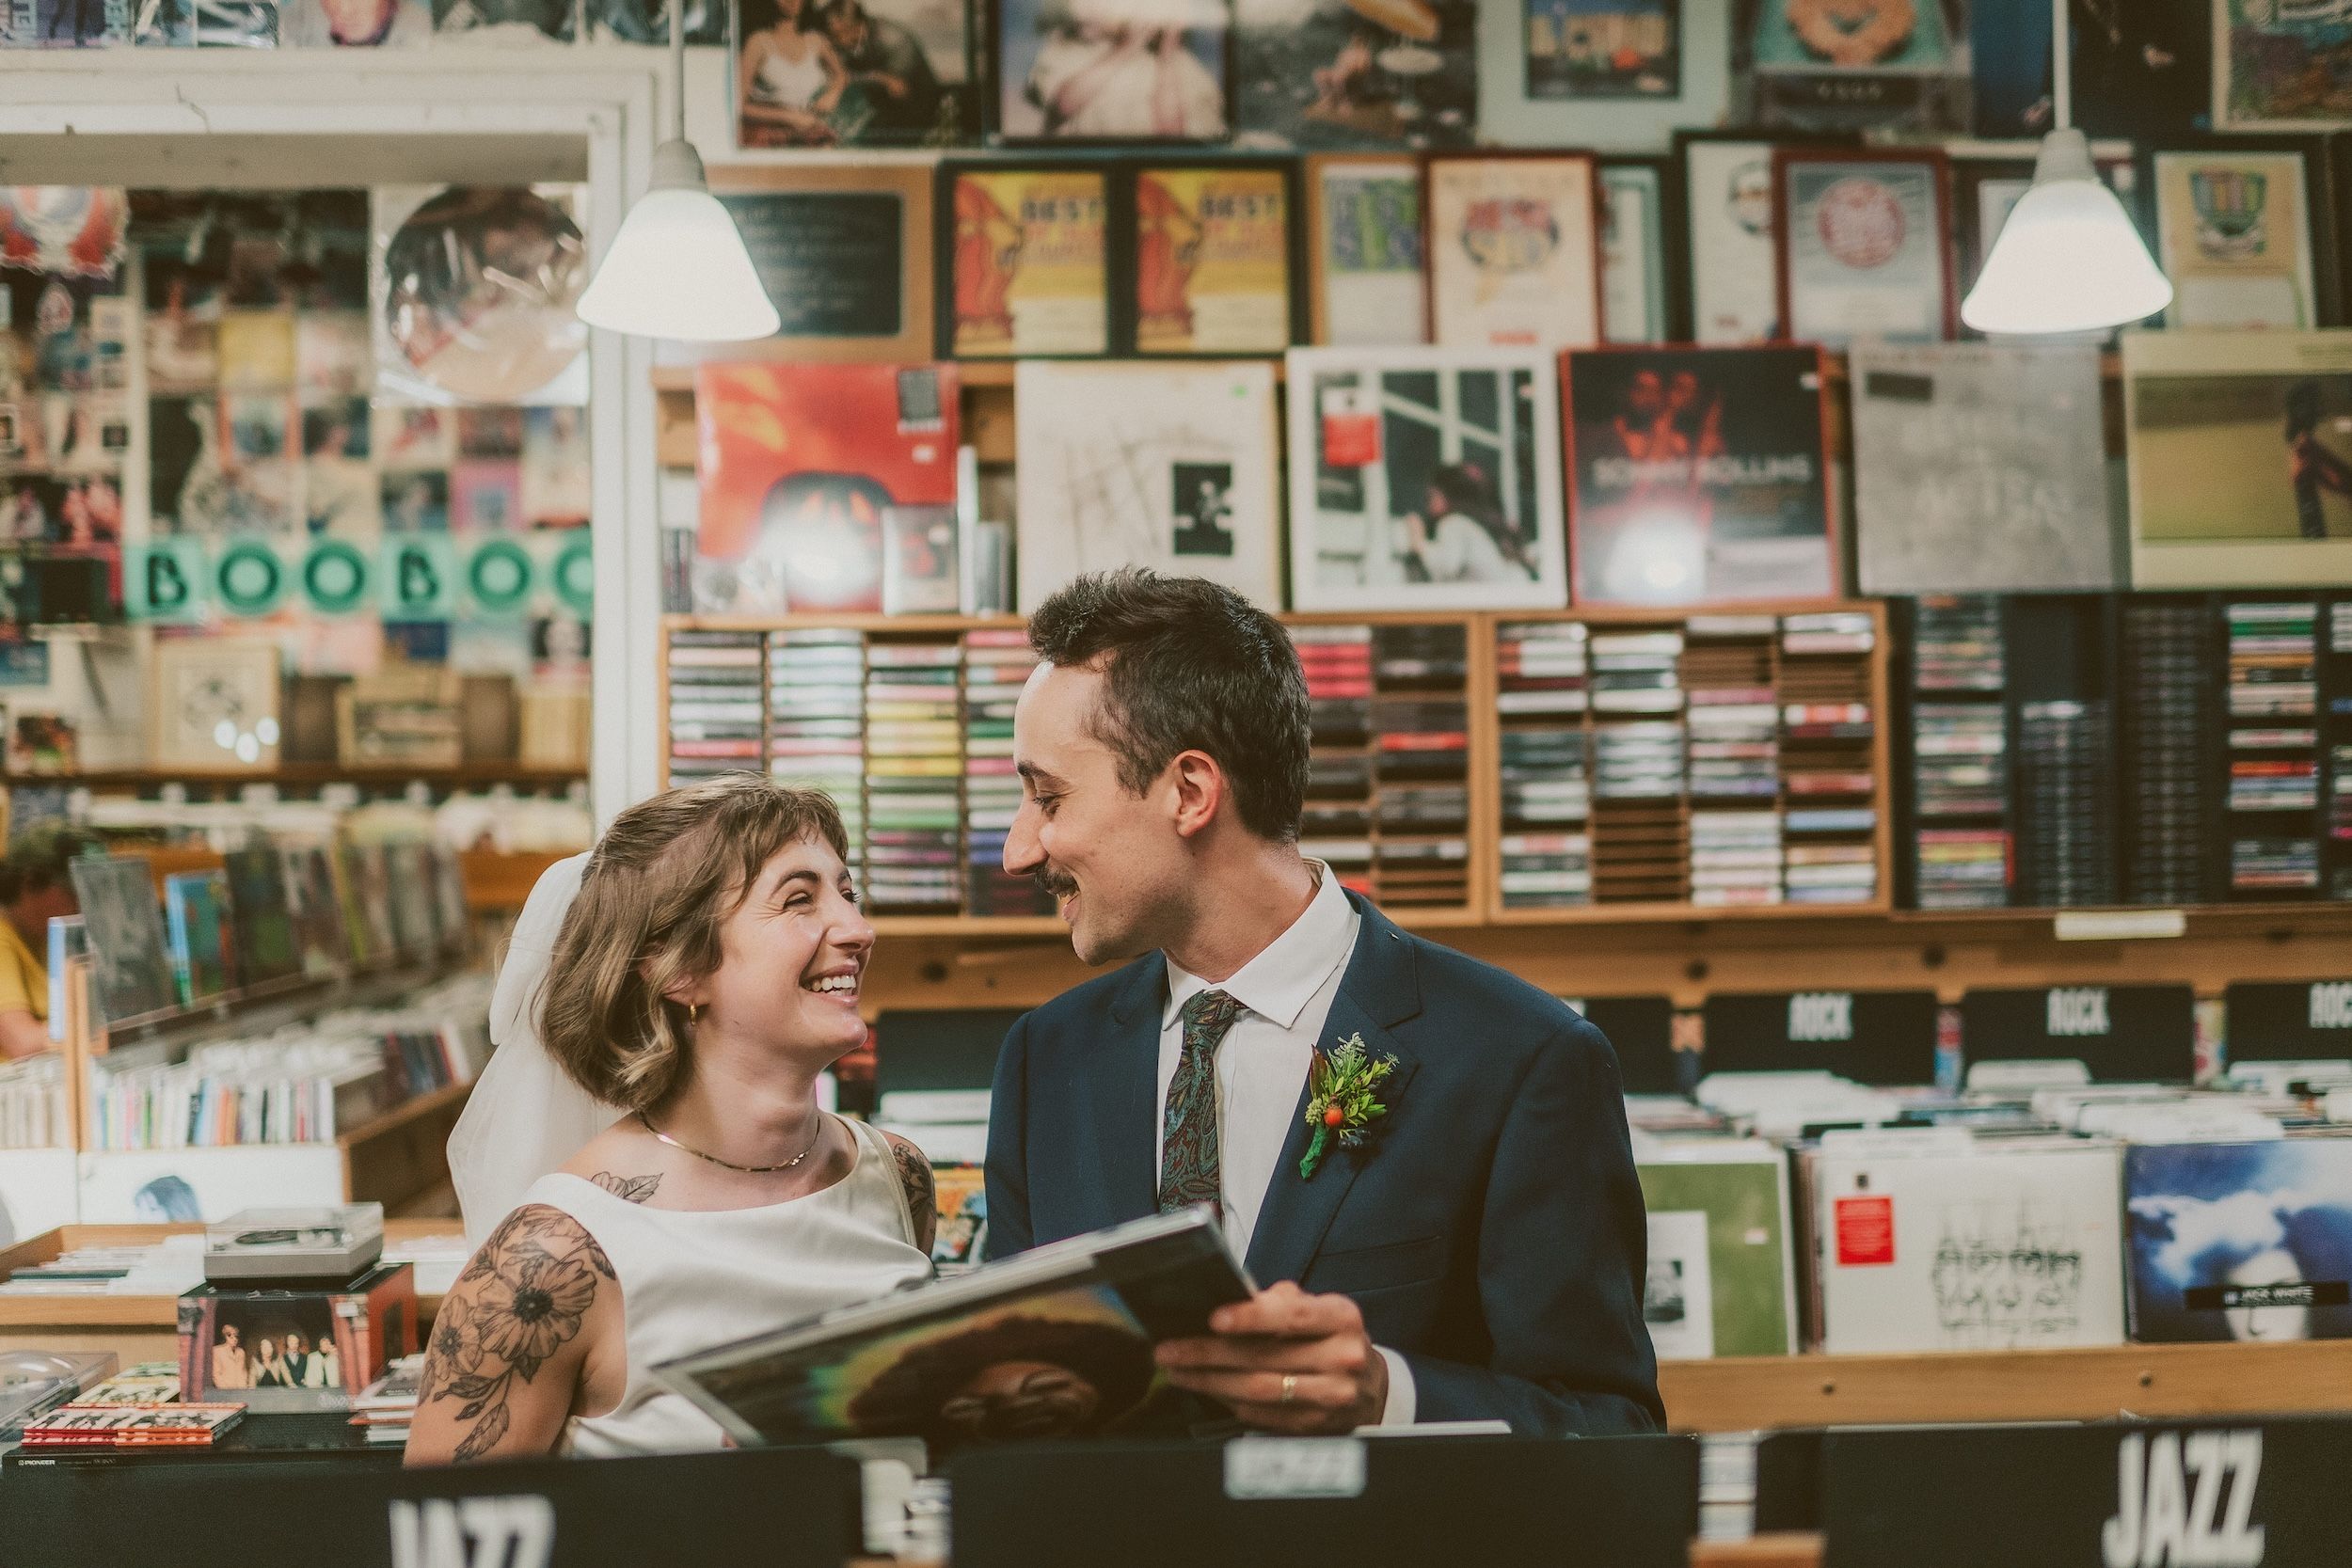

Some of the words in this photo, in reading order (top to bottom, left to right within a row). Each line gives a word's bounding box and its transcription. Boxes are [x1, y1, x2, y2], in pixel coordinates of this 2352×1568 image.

[1789, 993, 1851, 1040] ROCK
[2046, 988, 2110, 1035] ROCK
[2309, 982, 2352, 1028] ROC
[2100, 1429, 2266, 1568] JAZZ
